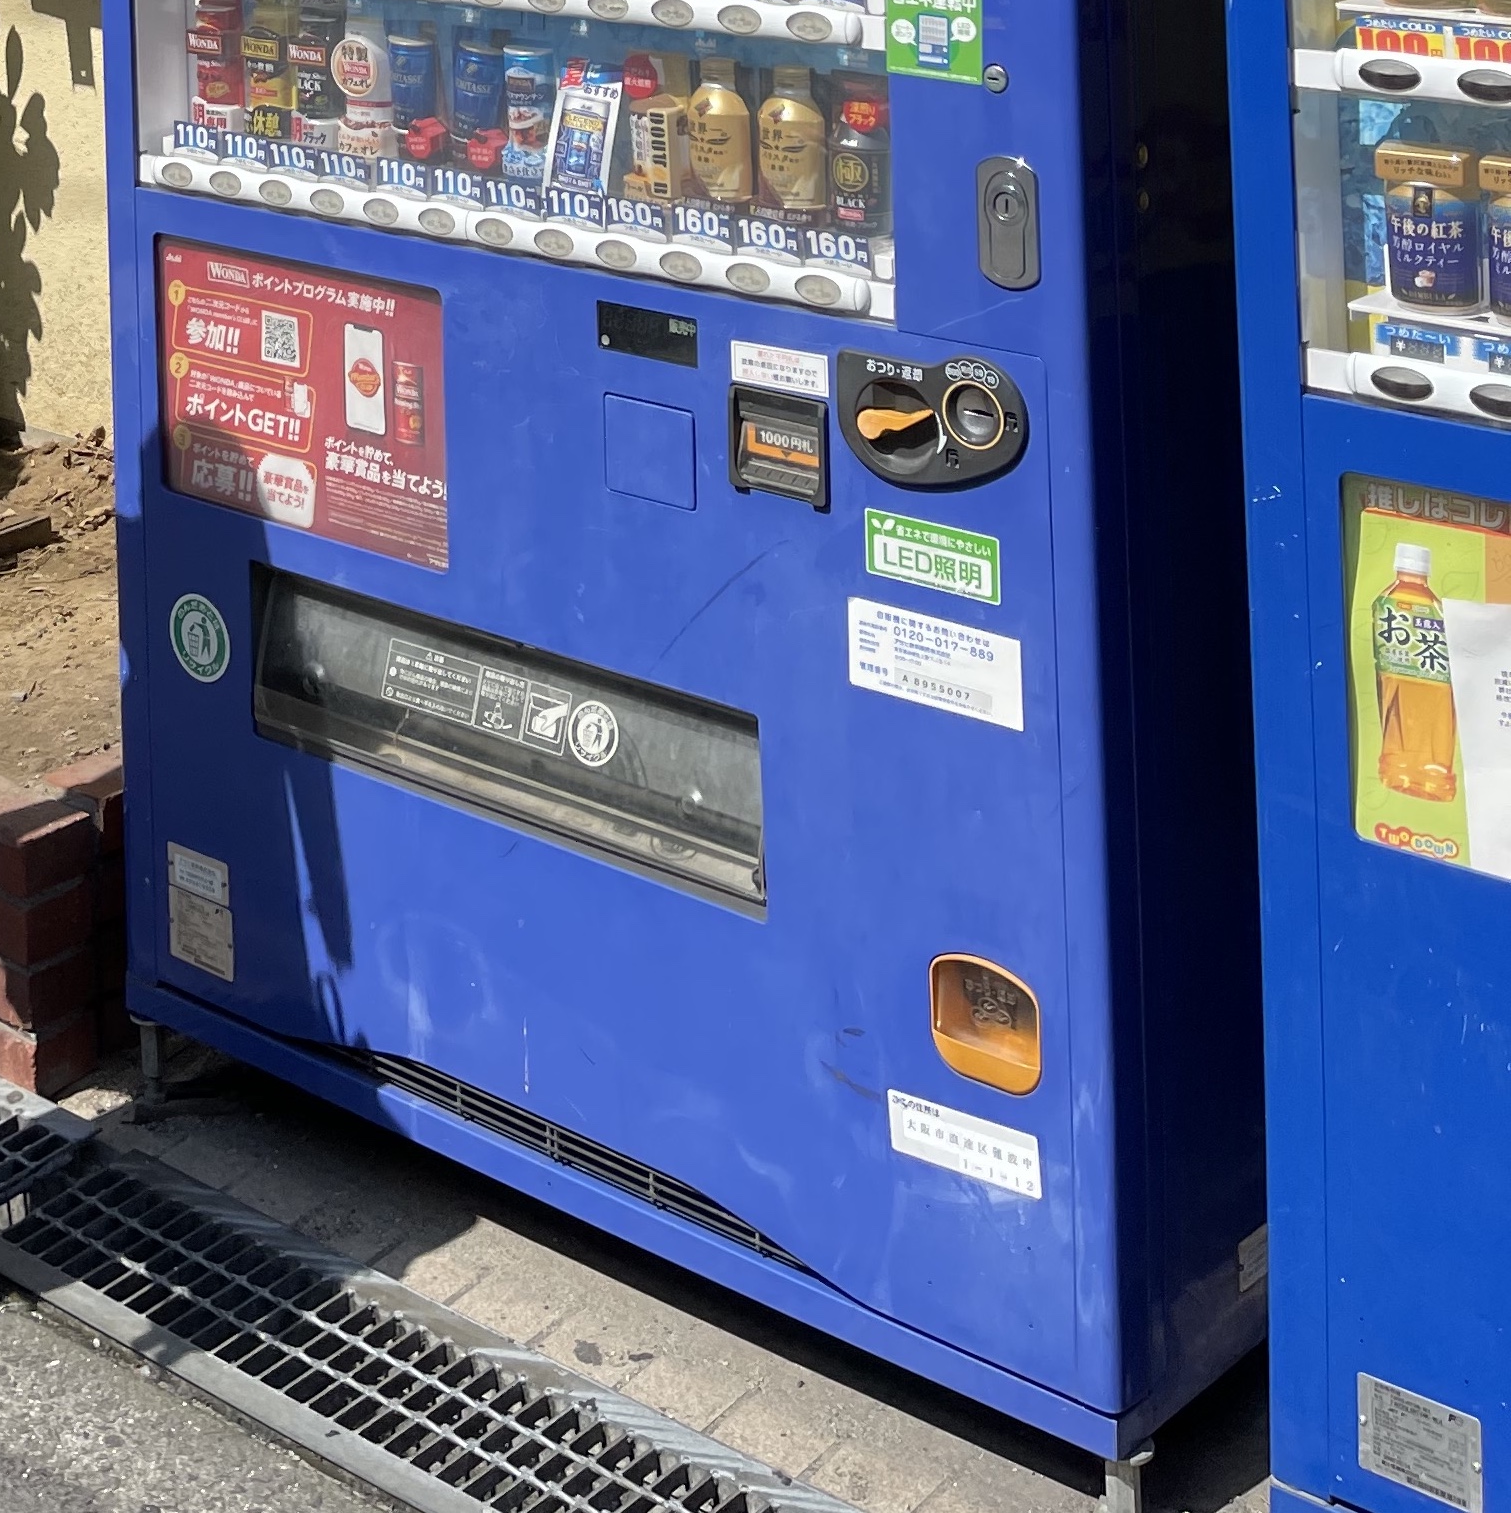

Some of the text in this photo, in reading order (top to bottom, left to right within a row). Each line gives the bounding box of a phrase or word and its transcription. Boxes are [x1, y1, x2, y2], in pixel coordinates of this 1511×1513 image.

[1365, 18, 1436, 33] つめたい COLD
[1461, 27, 1496, 38] つめたい
[188, 33, 219, 50] WONDA
[243, 38, 275, 55] WONDA
[289, 44, 322, 61] WONDA
[342, 45, 368, 62] 特製
[341, 77, 372, 88] カフェオレ
[343, 63, 368, 75] WONDA
[298, 79, 321, 91] LACK
[176, 124, 216, 150] 110円
[224, 133, 265, 160] 110円
[339, 142, 378, 155] カフェオレ
[270, 143, 315, 170] 110円
[321, 152, 365, 179] 110円
[380, 159, 424, 188] 110円
[435, 168, 481, 198] 110円
[837, 157, 863, 184] 極
[487, 180, 536, 210] 110円
[550, 190, 599, 220] 110円
[836, 196, 866, 208] BLACK
[608, 198, 662, 228] 160円
[675, 207, 729, 238] 160円
[739, 219, 797, 252] 160円
[1390, 214, 1464, 240] 午後の紅茶
[807, 230, 868, 263] 160円
[1395, 252, 1459, 267] ミルクティー
[210, 263, 396, 318] WONDA ポイントプログラム実施中!!
[186, 317, 240, 354] 参加!!
[175, 362, 181, 374] 2
[866, 359, 923, 382] おつり・返却
[185, 393, 301, 442] ポイントGET!!
[760, 430, 813, 454] 1000円札
[191, 459, 253, 502] 応募!!
[325, 450, 447, 501] 豪華賞品を当てよう!
[267, 489, 305, 509] 当てよう!
[1365, 483, 1511, 530] 推しはコレ
[896, 524, 991, 556] 省エネで環境にやさしい
[883, 542, 982, 590] LED照明
[893, 626, 994, 662] 0120-017-889
[1378, 607, 1449, 672] お茶
[902, 674, 908, 682] A
[914, 677, 970, 700] 8955007
[1379, 825, 1454, 856] TWO DOWN
